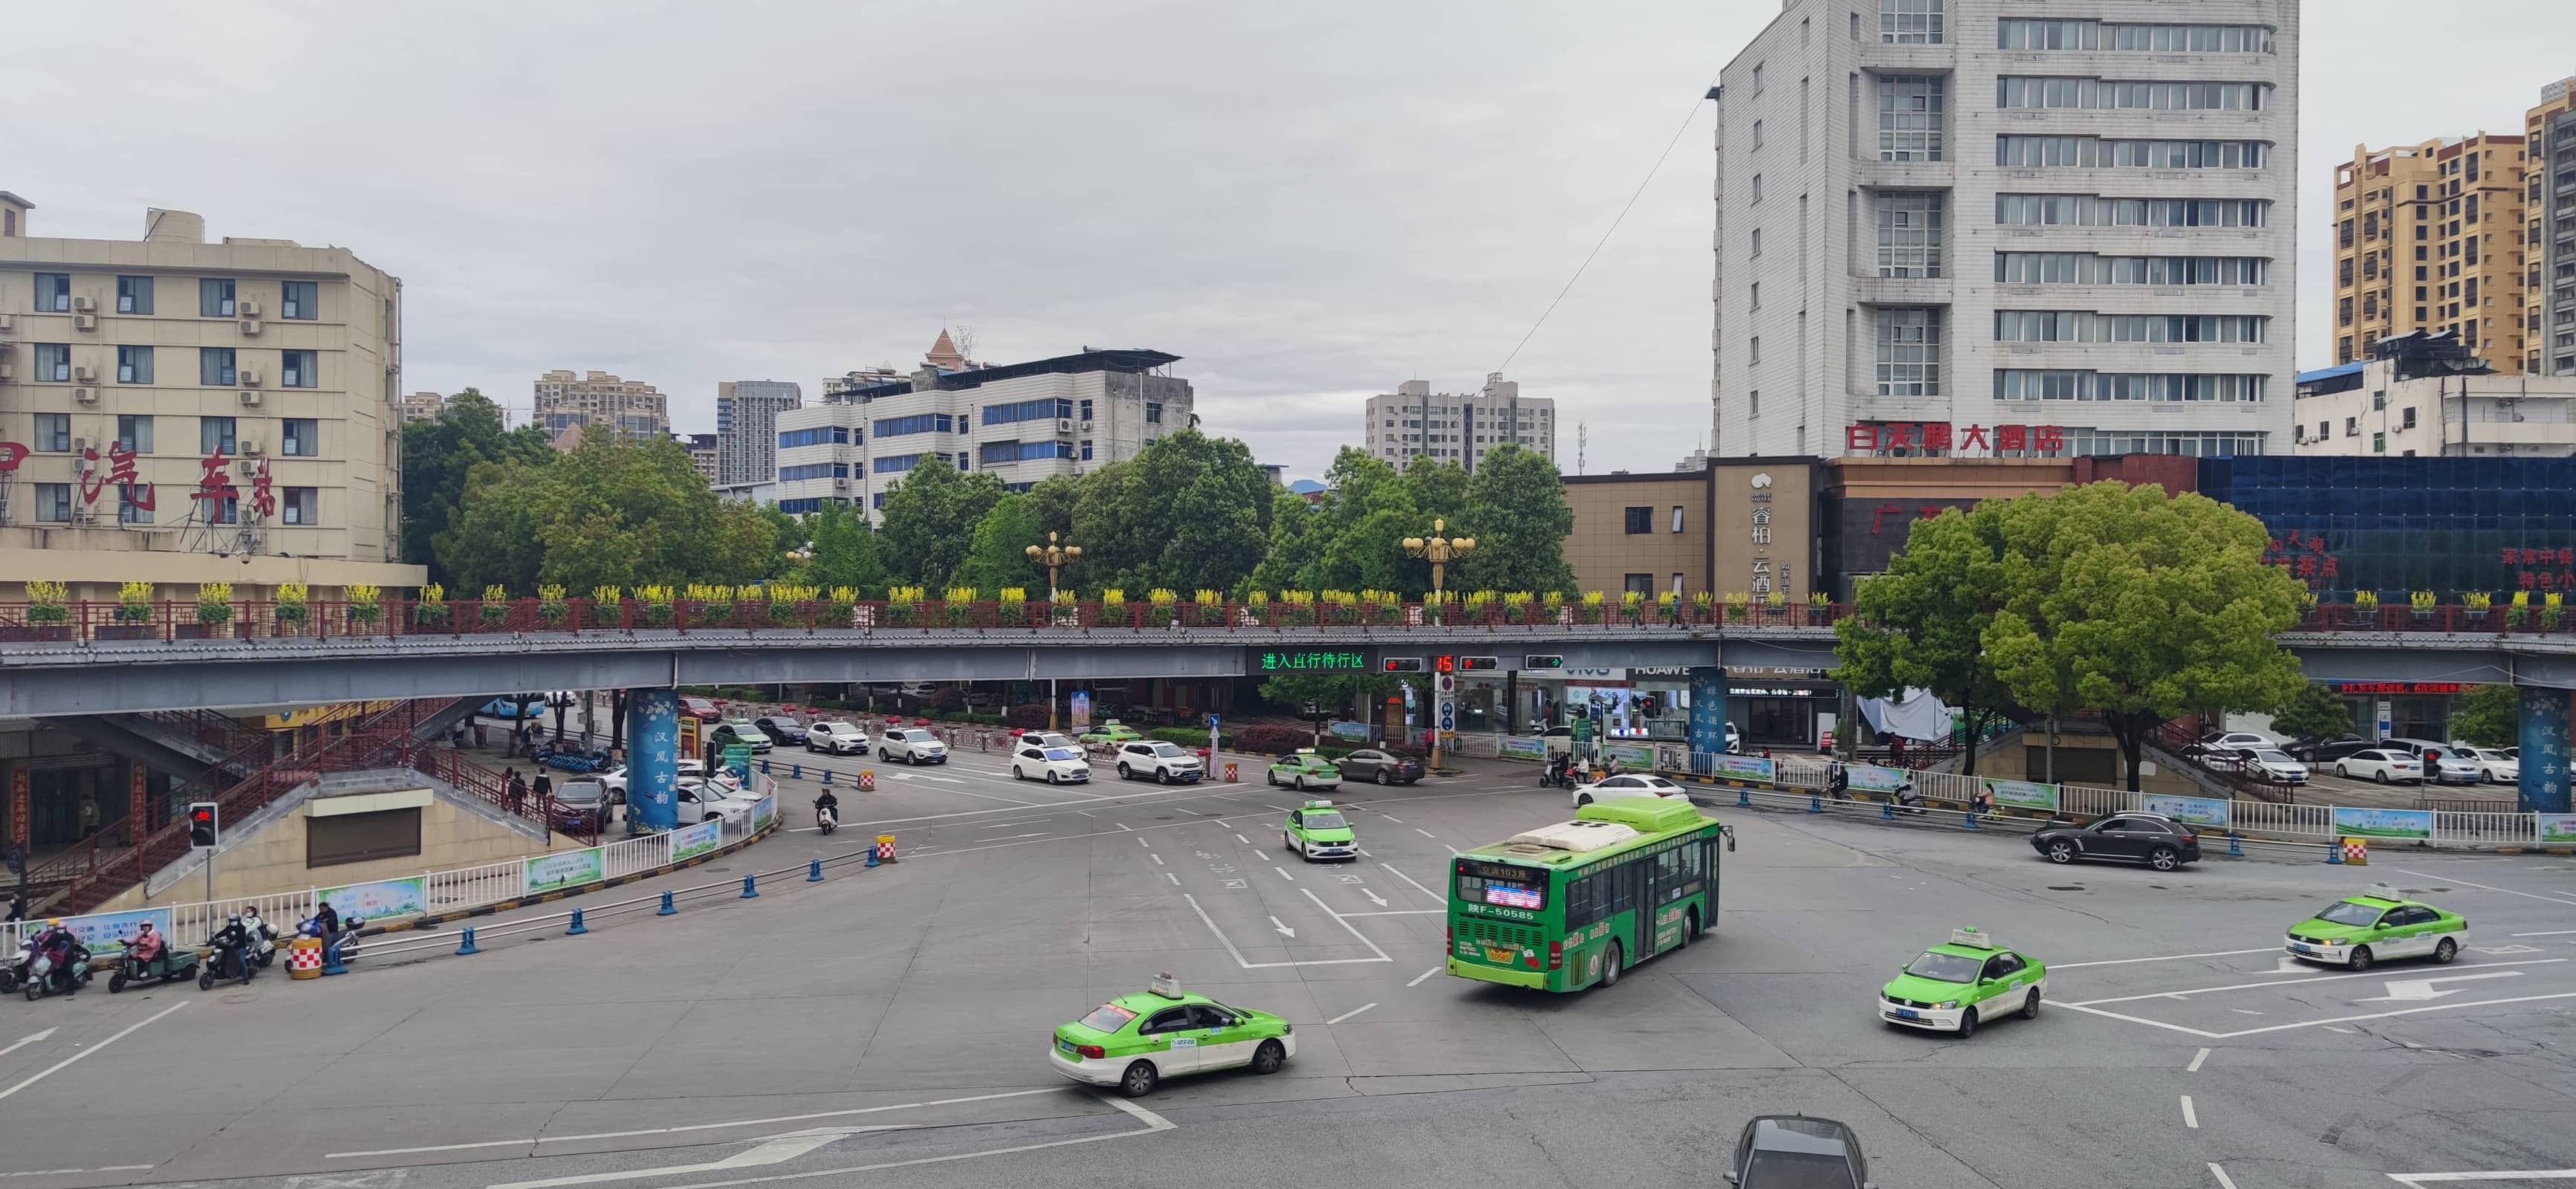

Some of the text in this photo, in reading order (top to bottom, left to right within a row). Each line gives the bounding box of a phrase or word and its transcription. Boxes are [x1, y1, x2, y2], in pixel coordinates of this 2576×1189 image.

[1849, 423, 2063, 451] 白天鹅大酒店
[1438, 655, 1453, 672] 15
[1635, 666, 1690, 676] HUAWE
[654, 731, 669, 804] 汉风古韵
[2541, 725, 2557, 794] 汉风古韵
[1468, 903, 1534, 920] 陕F-50585
